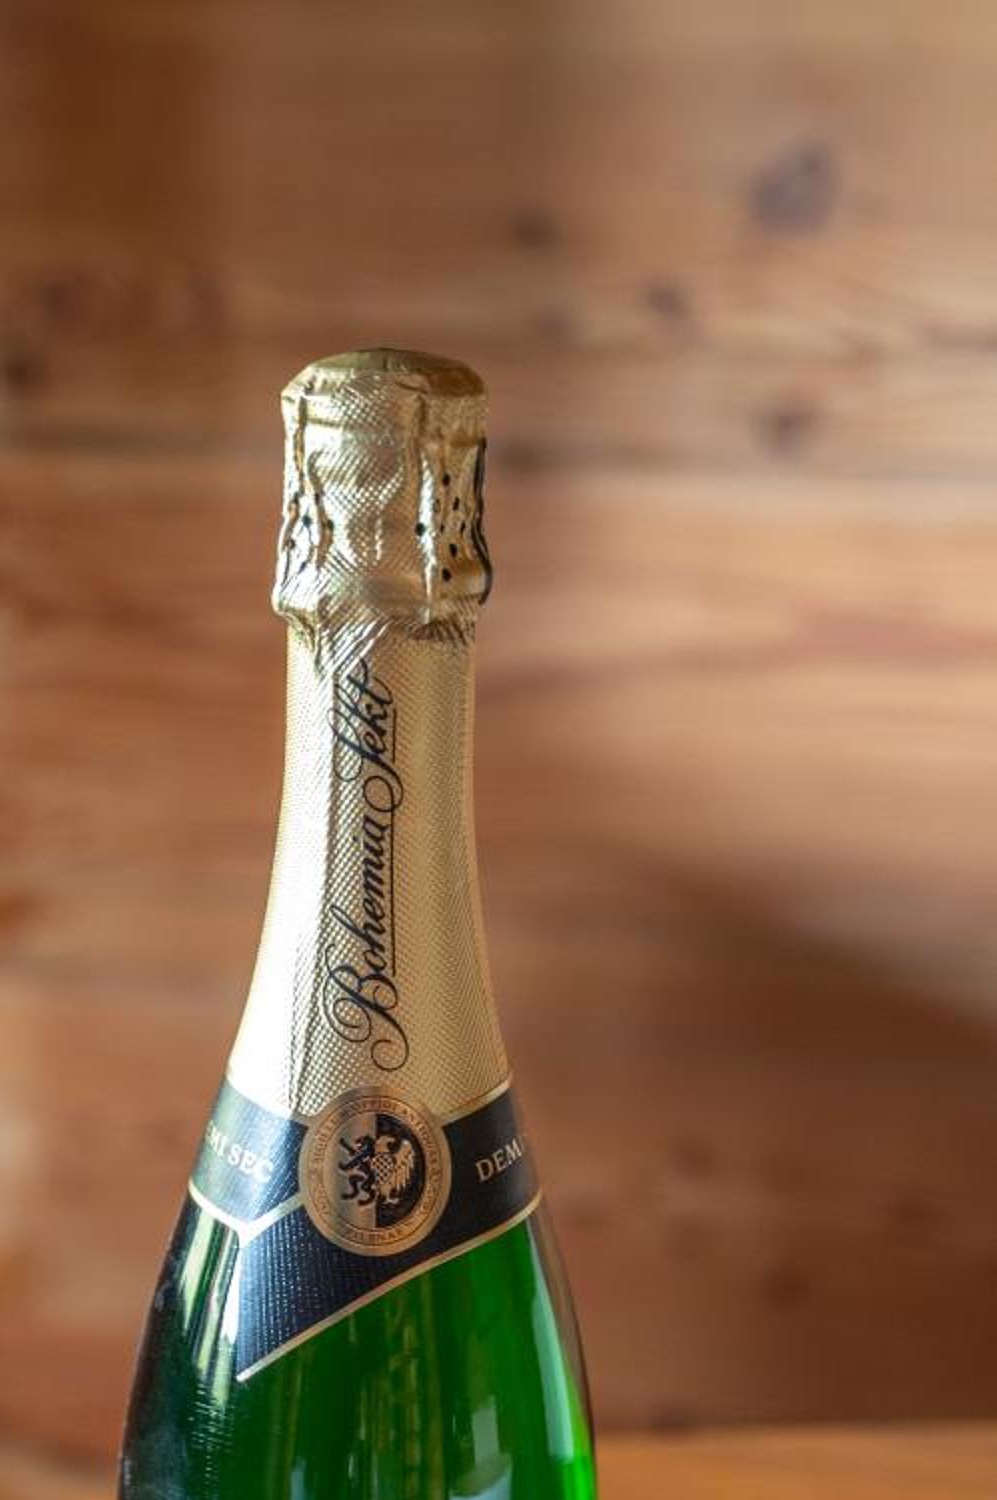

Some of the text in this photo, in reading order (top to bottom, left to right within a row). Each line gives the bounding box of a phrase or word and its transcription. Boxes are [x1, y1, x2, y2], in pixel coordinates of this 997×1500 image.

[326, 658, 403, 813] Sekt
[323, 814, 410, 1071] Bohemia
[475, 1138, 523, 1182] DEM
